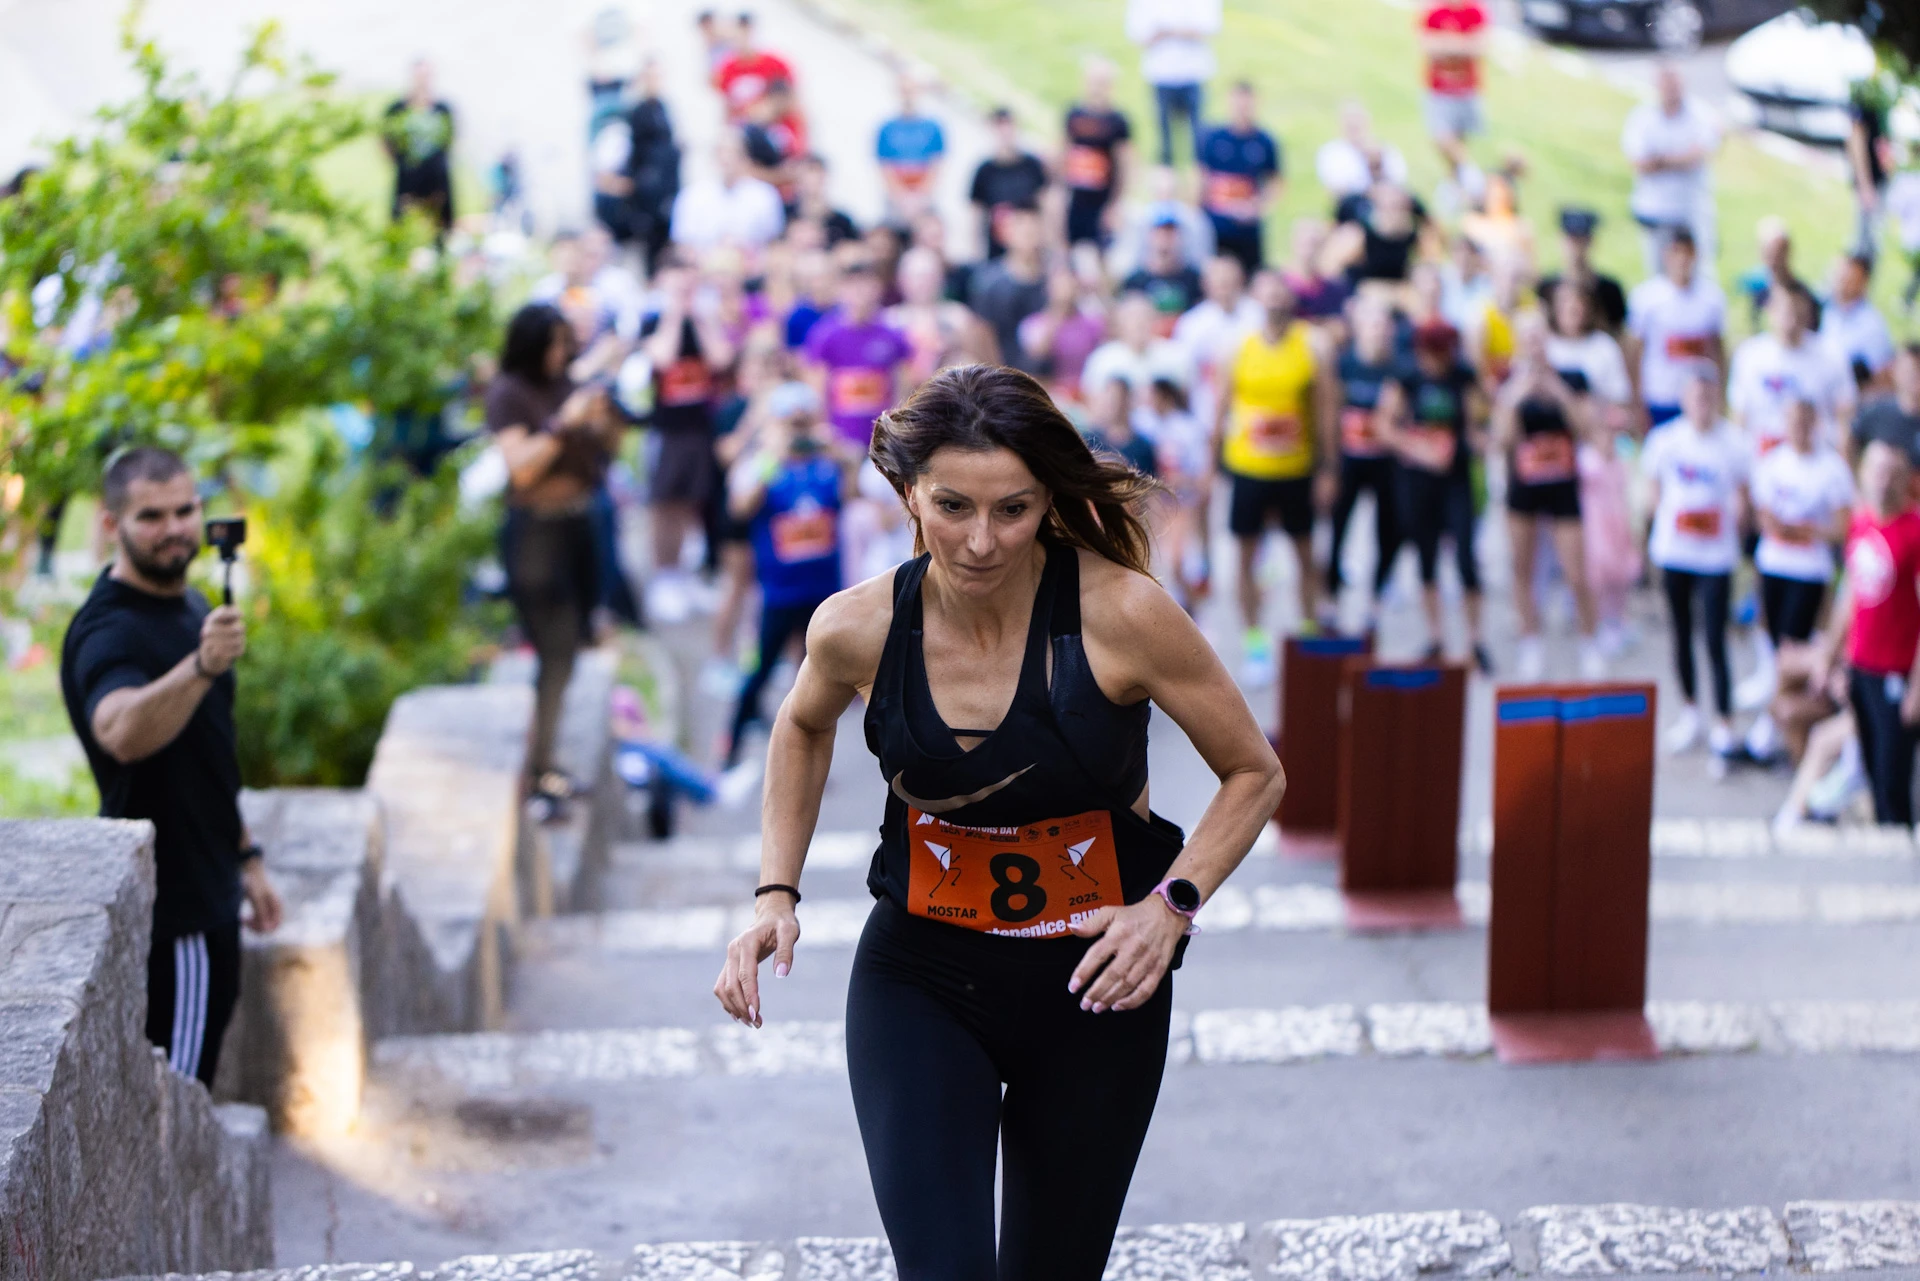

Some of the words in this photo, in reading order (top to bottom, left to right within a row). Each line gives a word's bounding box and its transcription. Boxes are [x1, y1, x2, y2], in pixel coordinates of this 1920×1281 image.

[999, 826, 1019, 835] DAY
[990, 853, 1047, 922] 8
[1069, 891, 1103, 907] 2025.
[927, 905, 977, 920] MOSTAR
[984, 920, 1067, 939] tepenice
